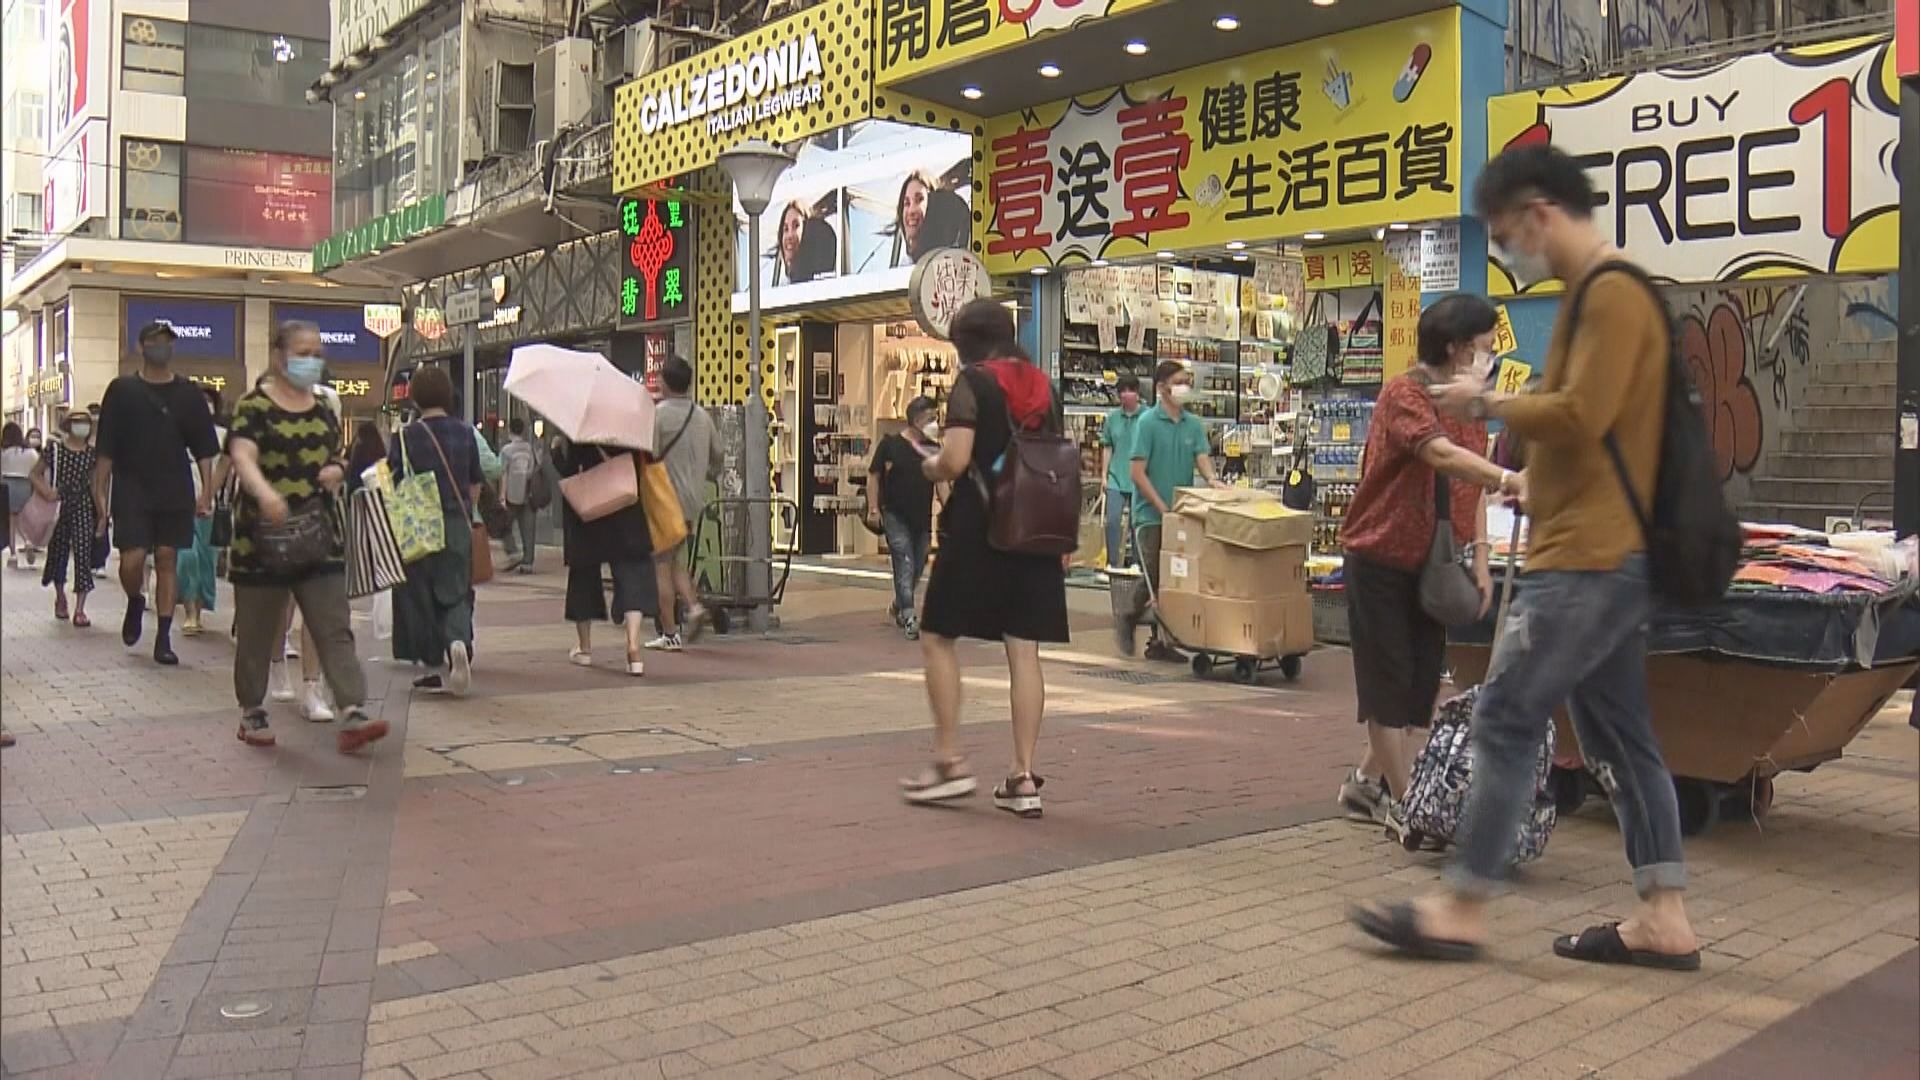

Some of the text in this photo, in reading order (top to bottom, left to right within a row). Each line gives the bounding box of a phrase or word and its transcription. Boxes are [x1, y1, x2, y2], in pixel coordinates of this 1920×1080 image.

[640, 33, 823, 135] CALZEDONIA
[706, 85, 822, 137] ITALIAN LEGWEAR
[1199, 71, 1302, 151] 健康
[1632, 90, 1740, 132] BUY
[988, 96, 1192, 255] 壹送壹
[1225, 121, 1455, 221] 生活百貨
[1788, 77, 1852, 239] 1
